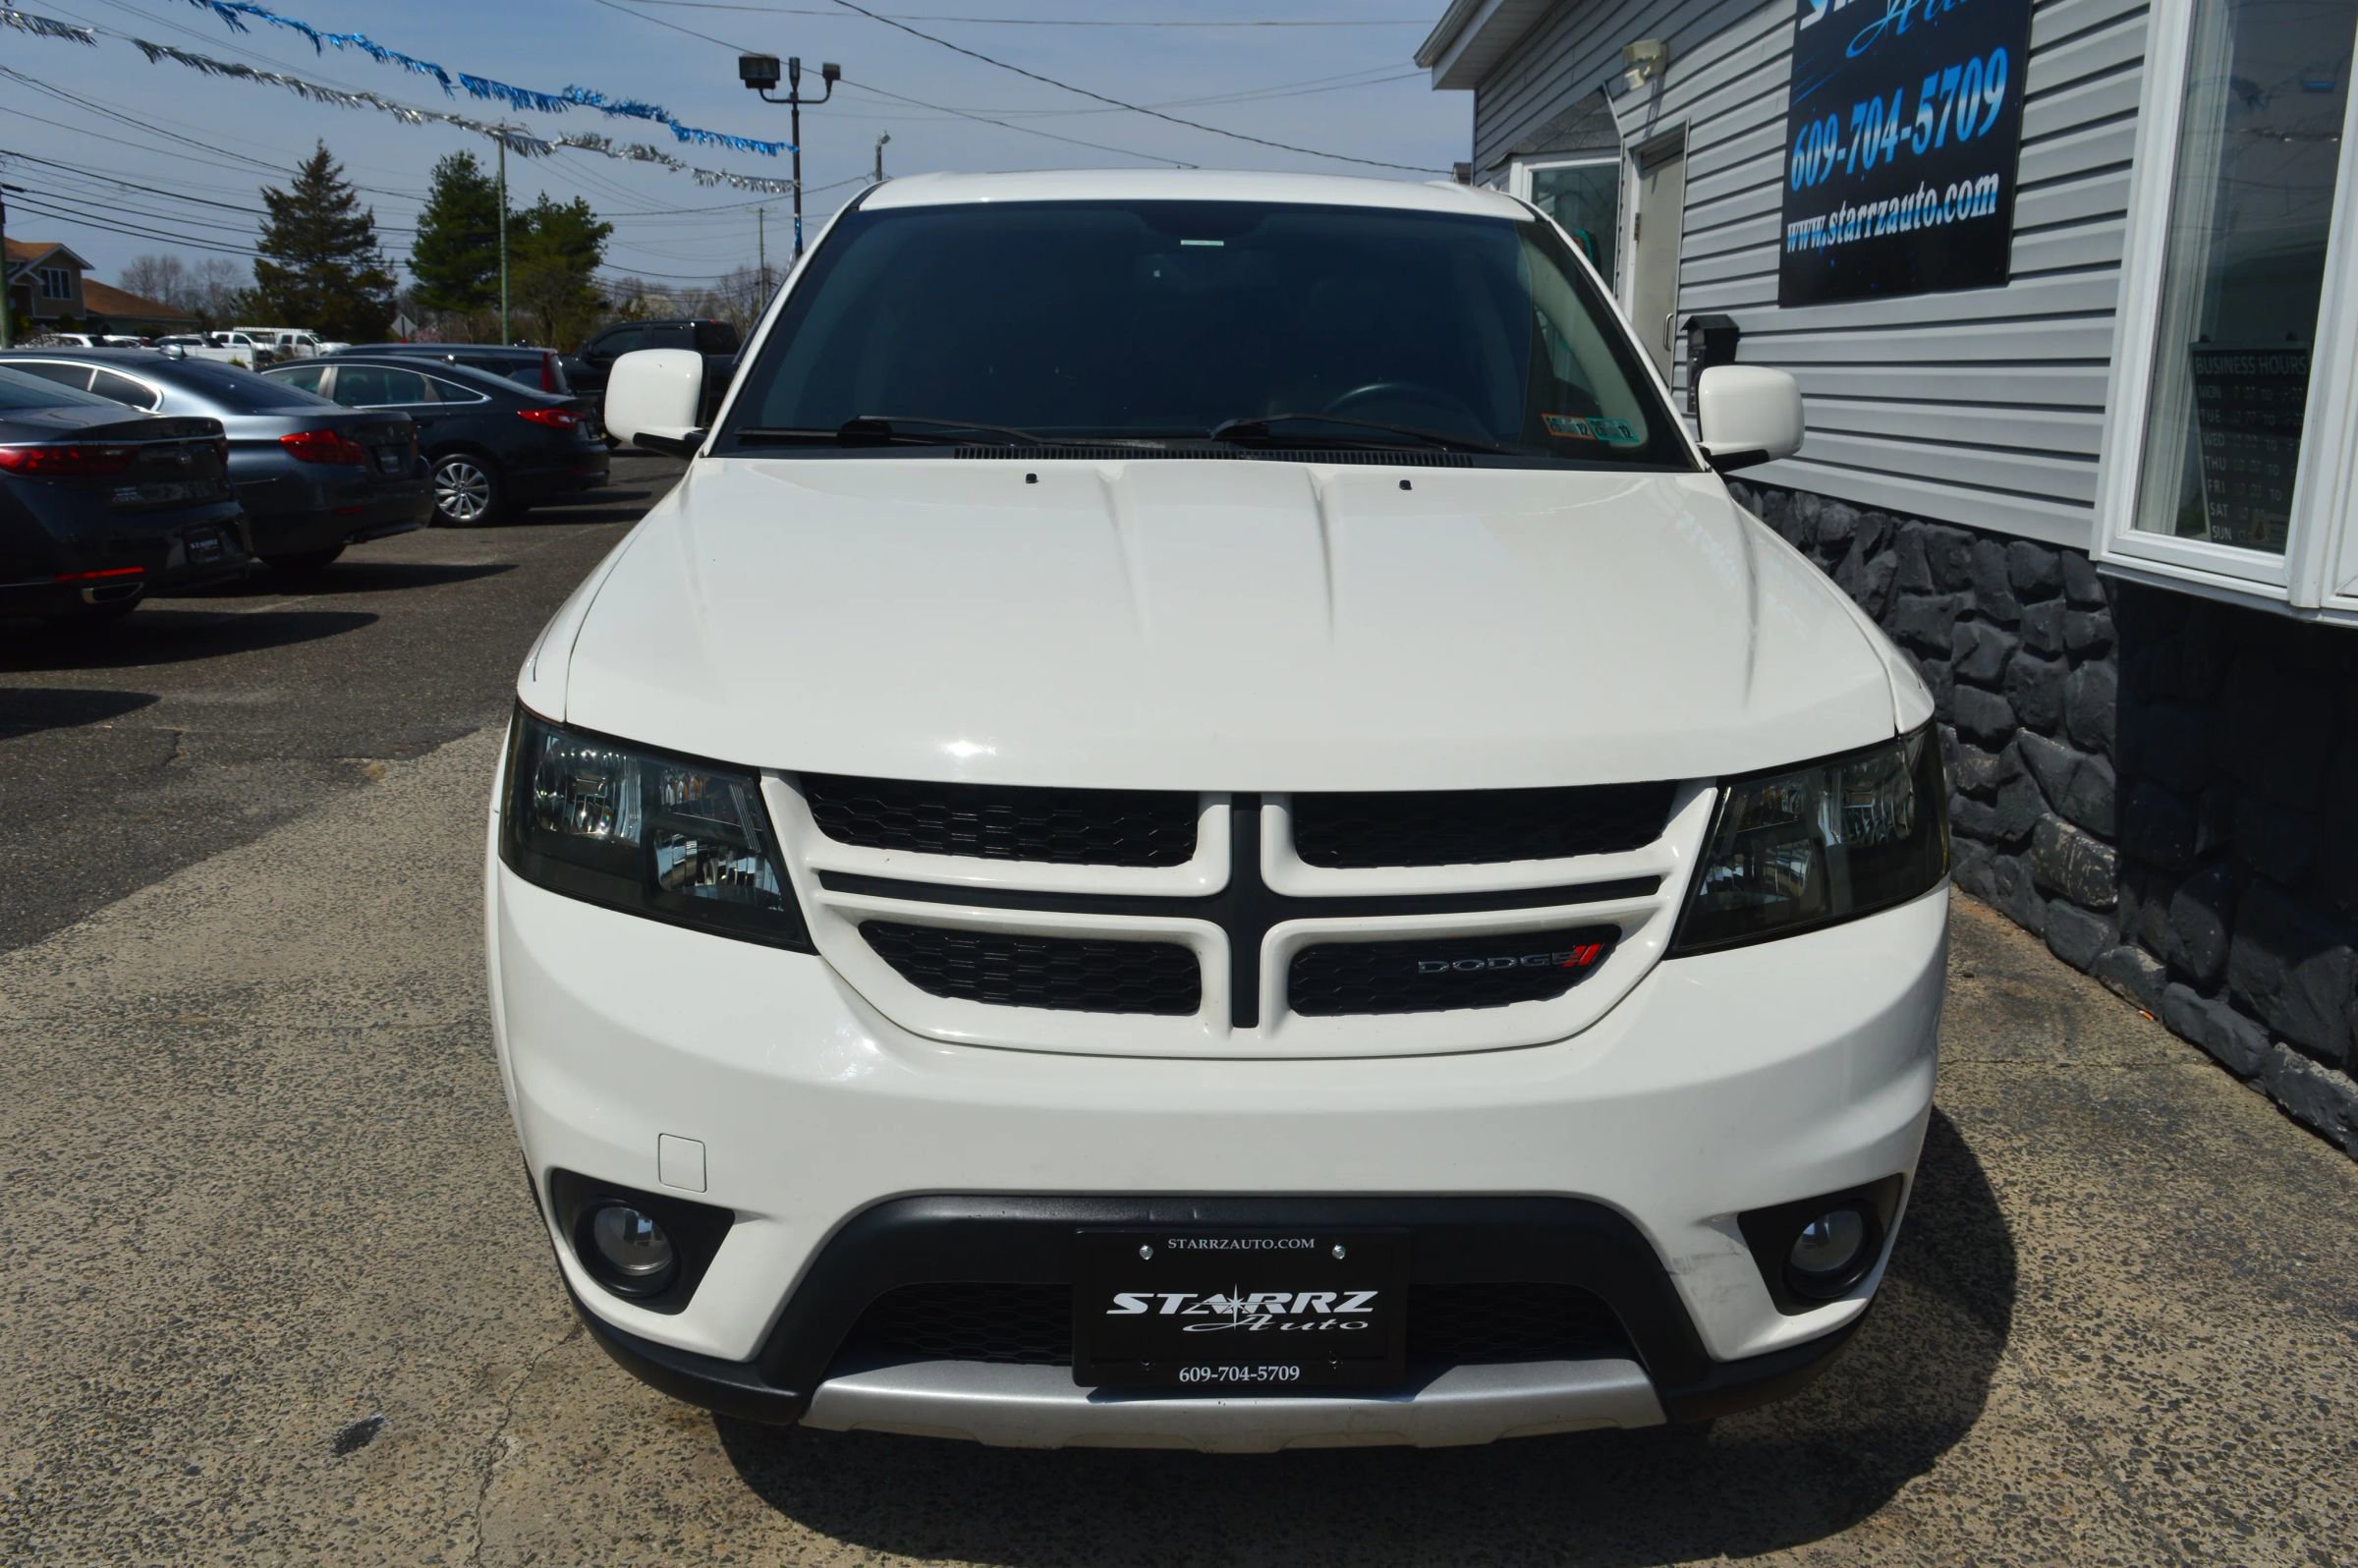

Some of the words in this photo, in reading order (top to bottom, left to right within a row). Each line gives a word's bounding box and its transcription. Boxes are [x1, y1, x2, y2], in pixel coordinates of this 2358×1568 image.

[1790, 46, 2008, 192] 609-704-5709
[1786, 172, 1999, 252] www.starrzauto.com
[2195, 356, 2256, 375] BUSINESS
[2260, 355, 2307, 375] HOURS
[2201, 409, 2221, 423] TUE
[2203, 432, 2225, 447] WED
[2205, 456, 2227, 472] THU
[2208, 478, 2225, 495] FRI
[2210, 503, 2228, 518] SAT
[2212, 525, 2232, 541] SUN
[1418, 951, 1580, 974] DODGE
[1167, 1238, 1316, 1250] STARRZAUTO.COM
[1105, 1290, 1378, 1316] STARRZ
[1182, 1314, 1369, 1332] Auto
[1178, 1366, 1300, 1382] 609-704-5709
